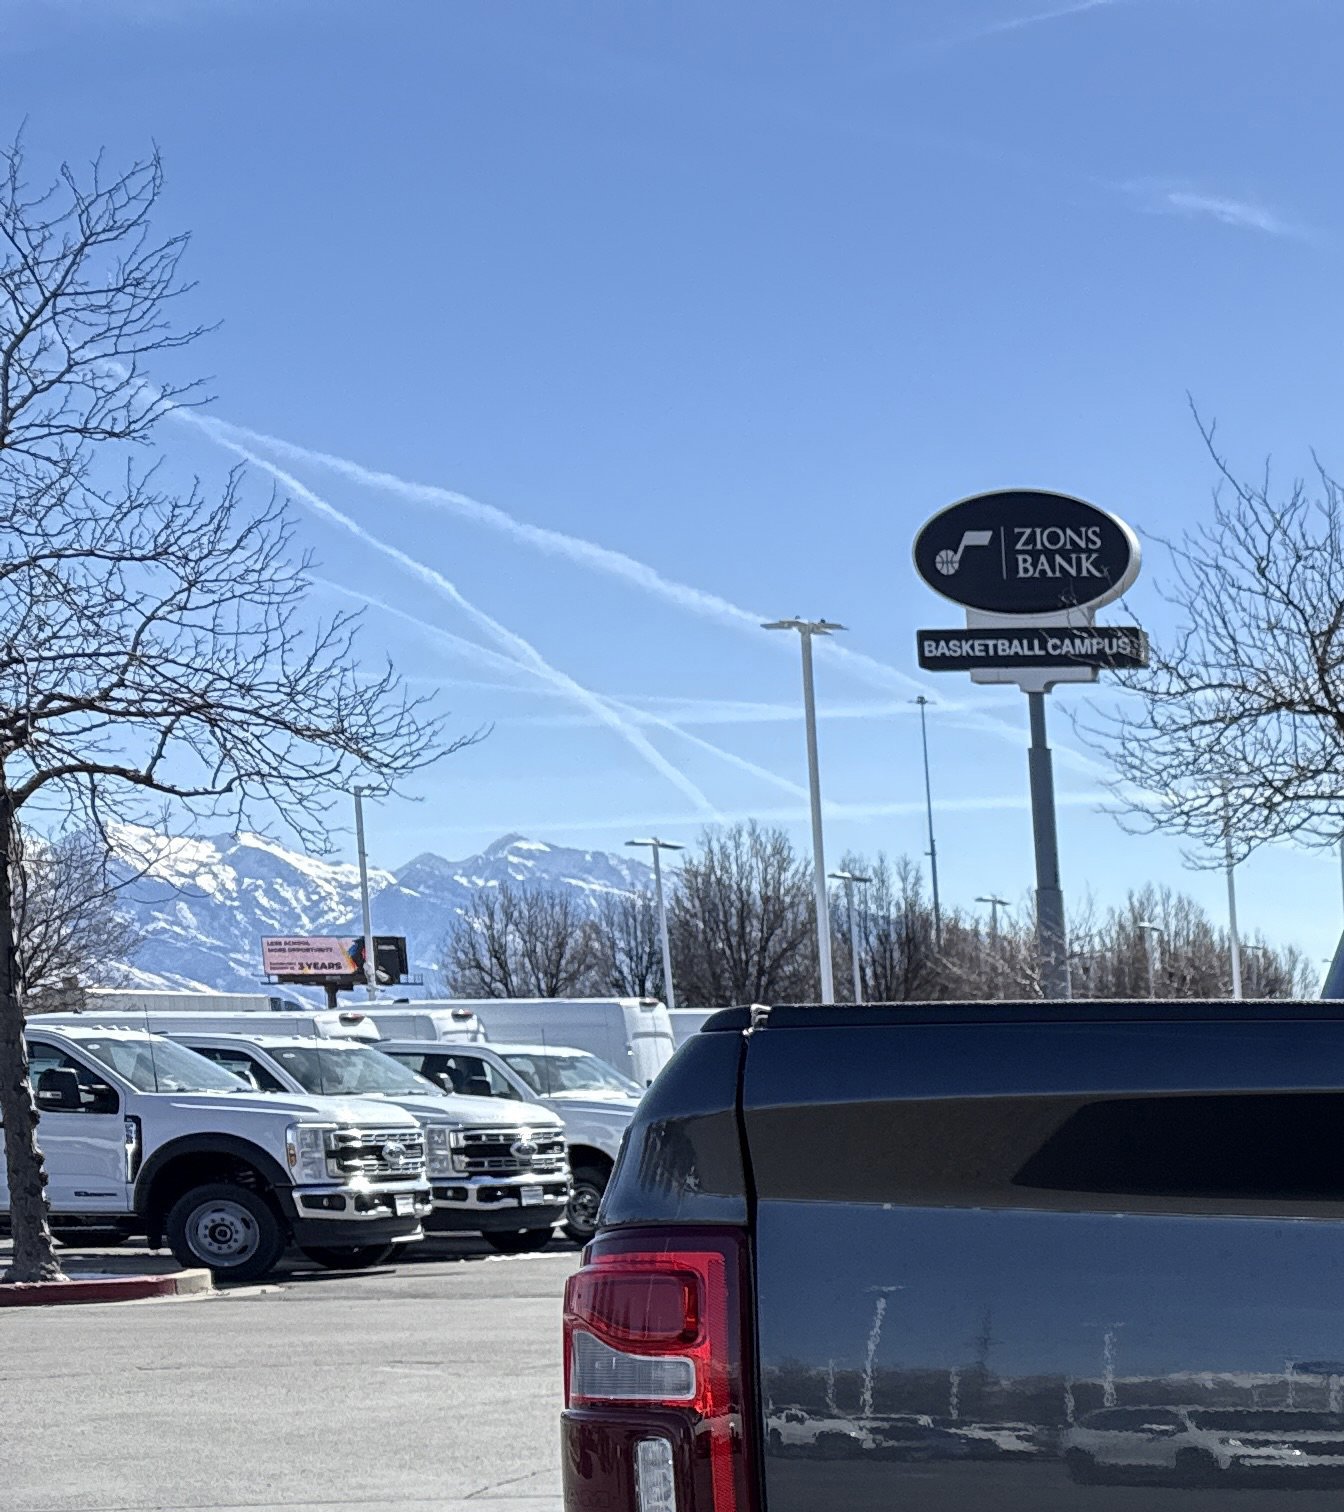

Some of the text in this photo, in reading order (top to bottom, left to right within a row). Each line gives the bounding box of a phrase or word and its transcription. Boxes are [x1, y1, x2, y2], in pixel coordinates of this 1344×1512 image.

[1013, 526, 1102, 551] ZIONS
[1015, 553, 1104, 578] BANK
[923, 636, 1131, 657] BASKETBALL CAMPUS
[306, 962, 342, 970] YEARS
